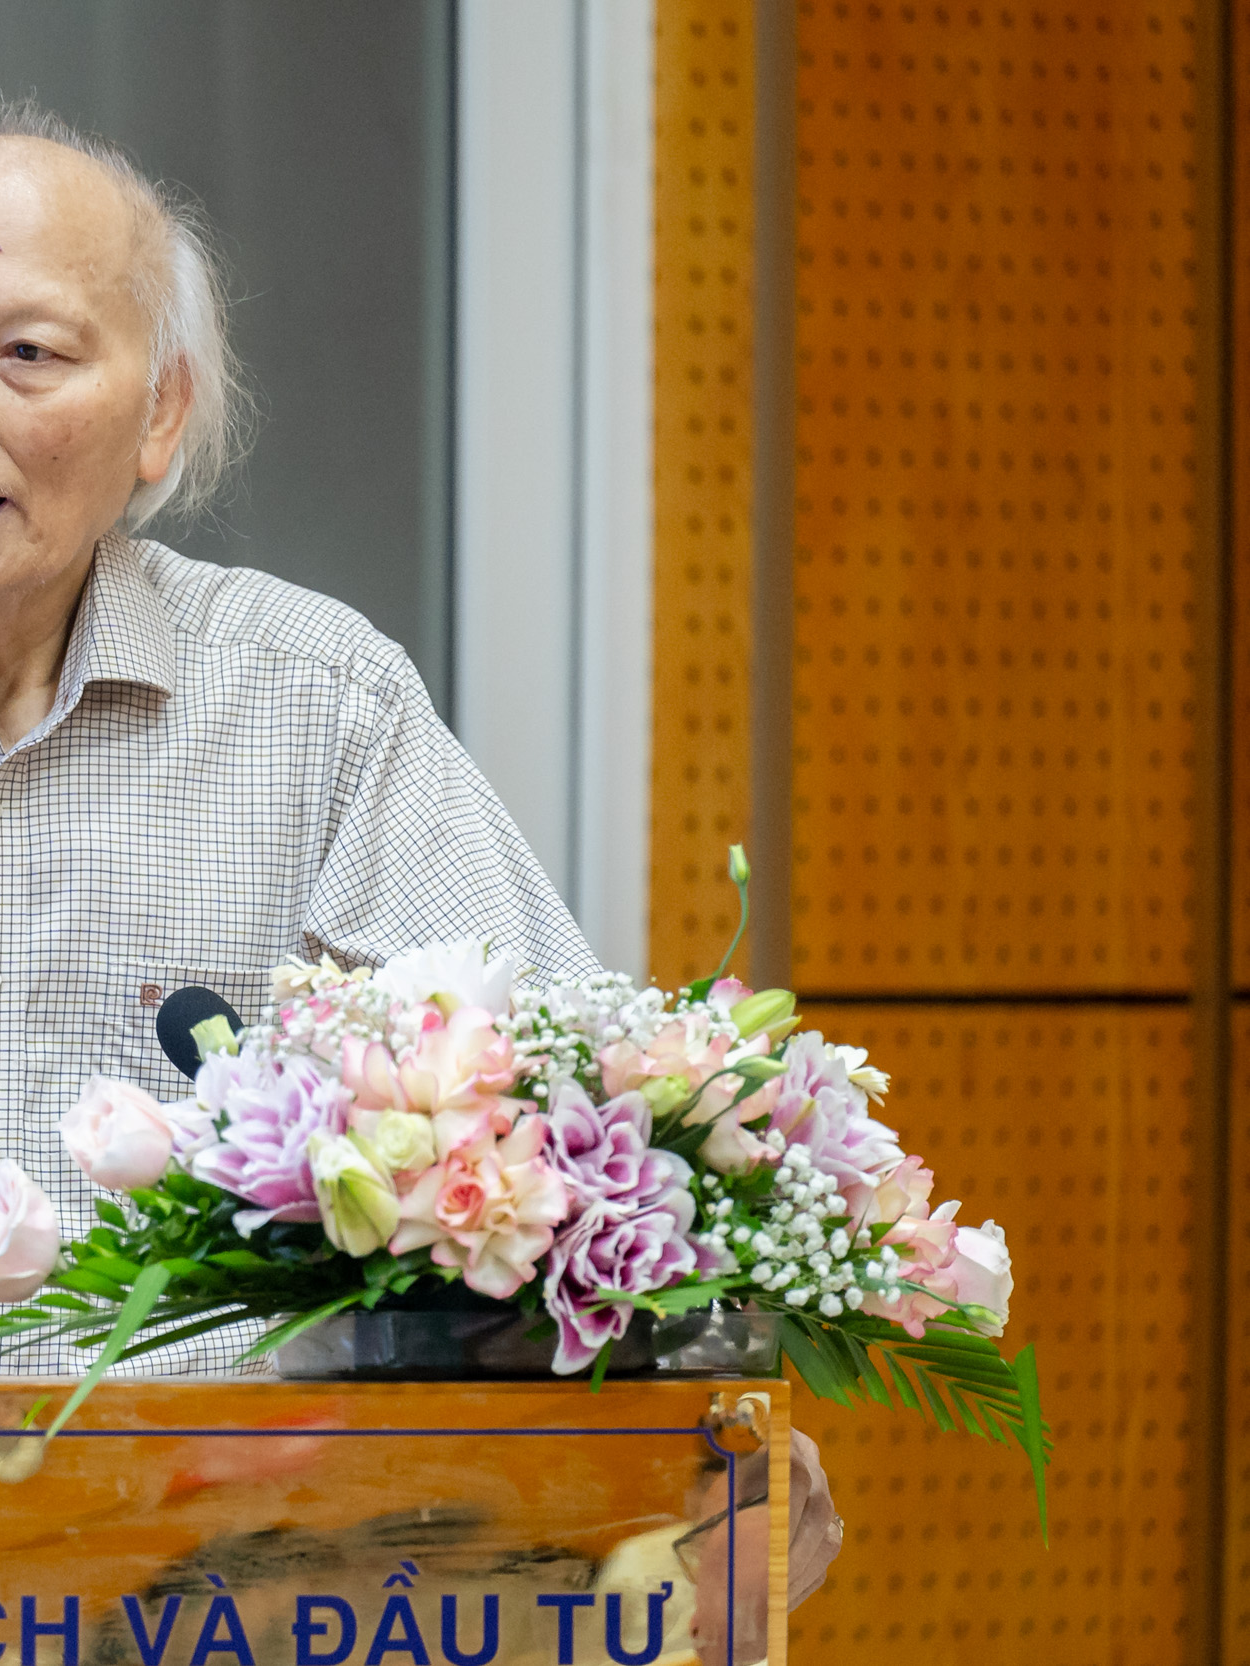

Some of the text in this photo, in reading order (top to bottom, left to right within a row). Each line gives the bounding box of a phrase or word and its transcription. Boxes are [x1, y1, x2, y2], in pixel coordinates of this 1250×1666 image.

[121, 1574, 256, 1666] VÀ
[291, 1561, 499, 1666] ĐẦU
[536, 1581, 673, 1666] TƯ
